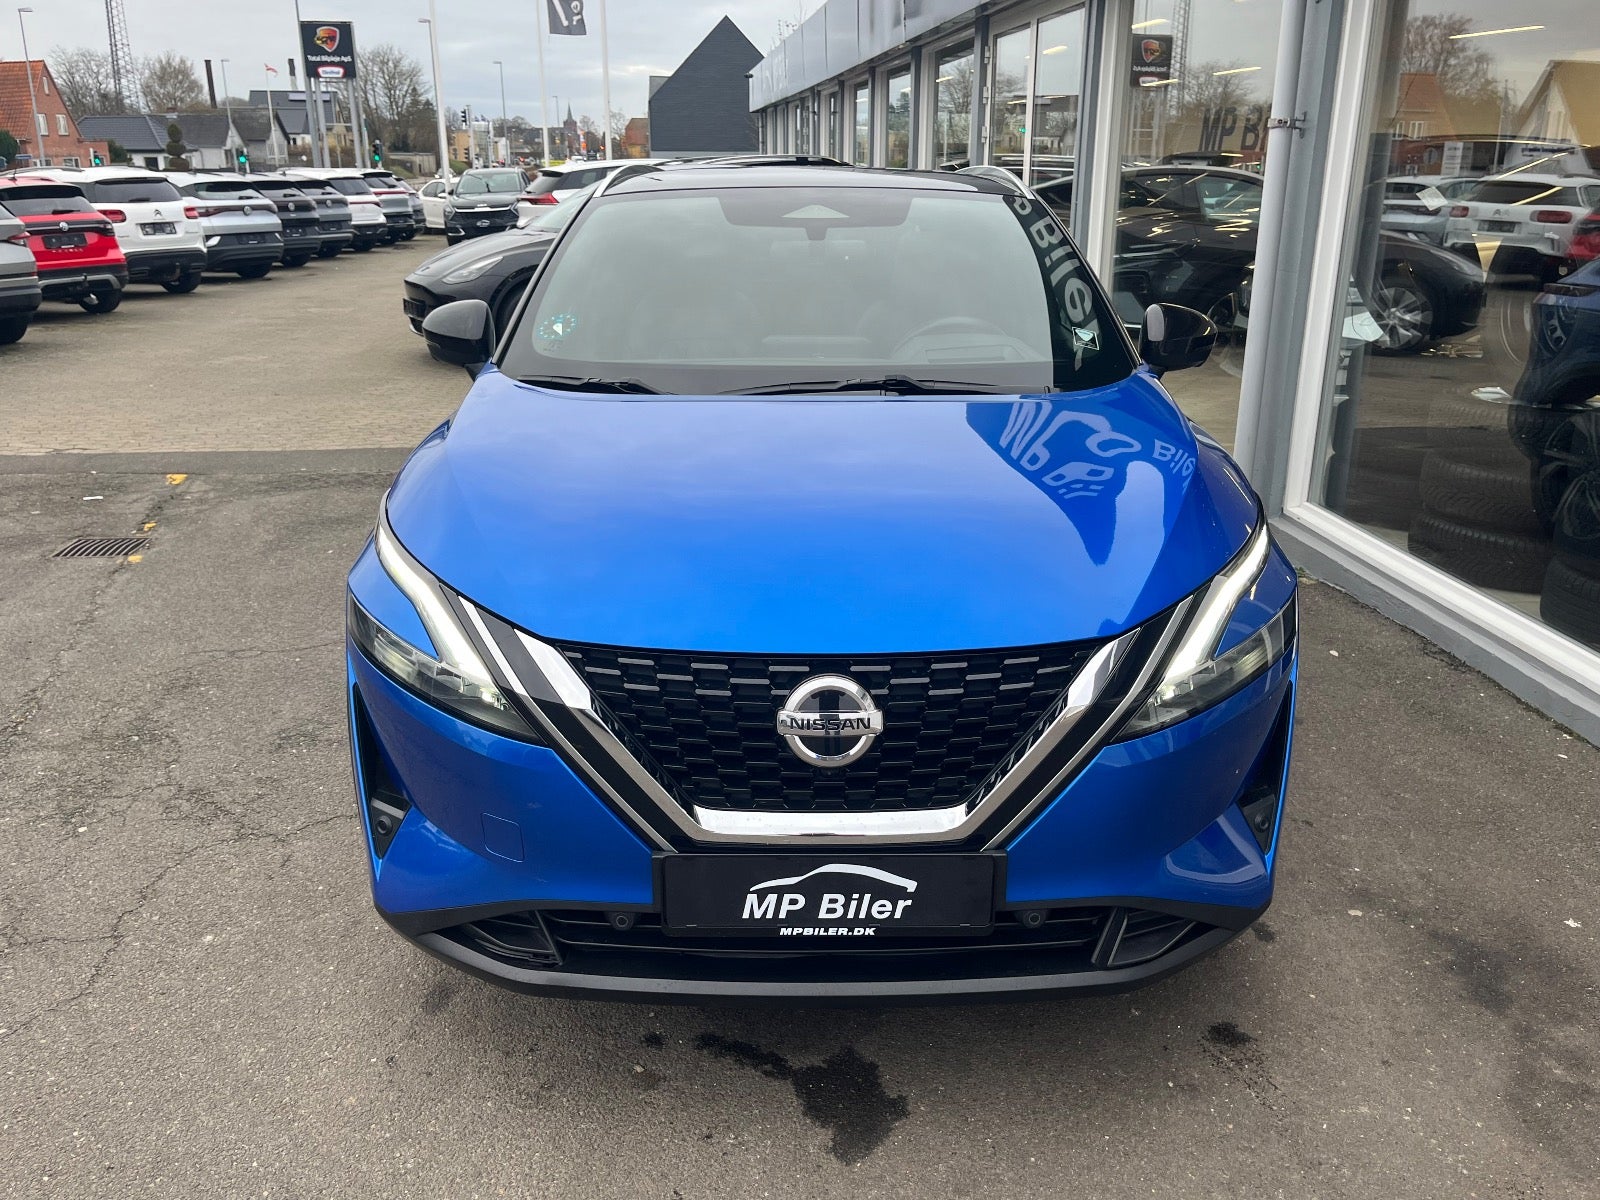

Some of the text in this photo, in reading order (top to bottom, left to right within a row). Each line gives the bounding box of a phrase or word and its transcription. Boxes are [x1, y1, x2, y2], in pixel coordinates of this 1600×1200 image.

[790, 717, 871, 731] NISSAN
[742, 893, 913, 919] MP Biler
[779, 927, 877, 937] MPBILER.DK
